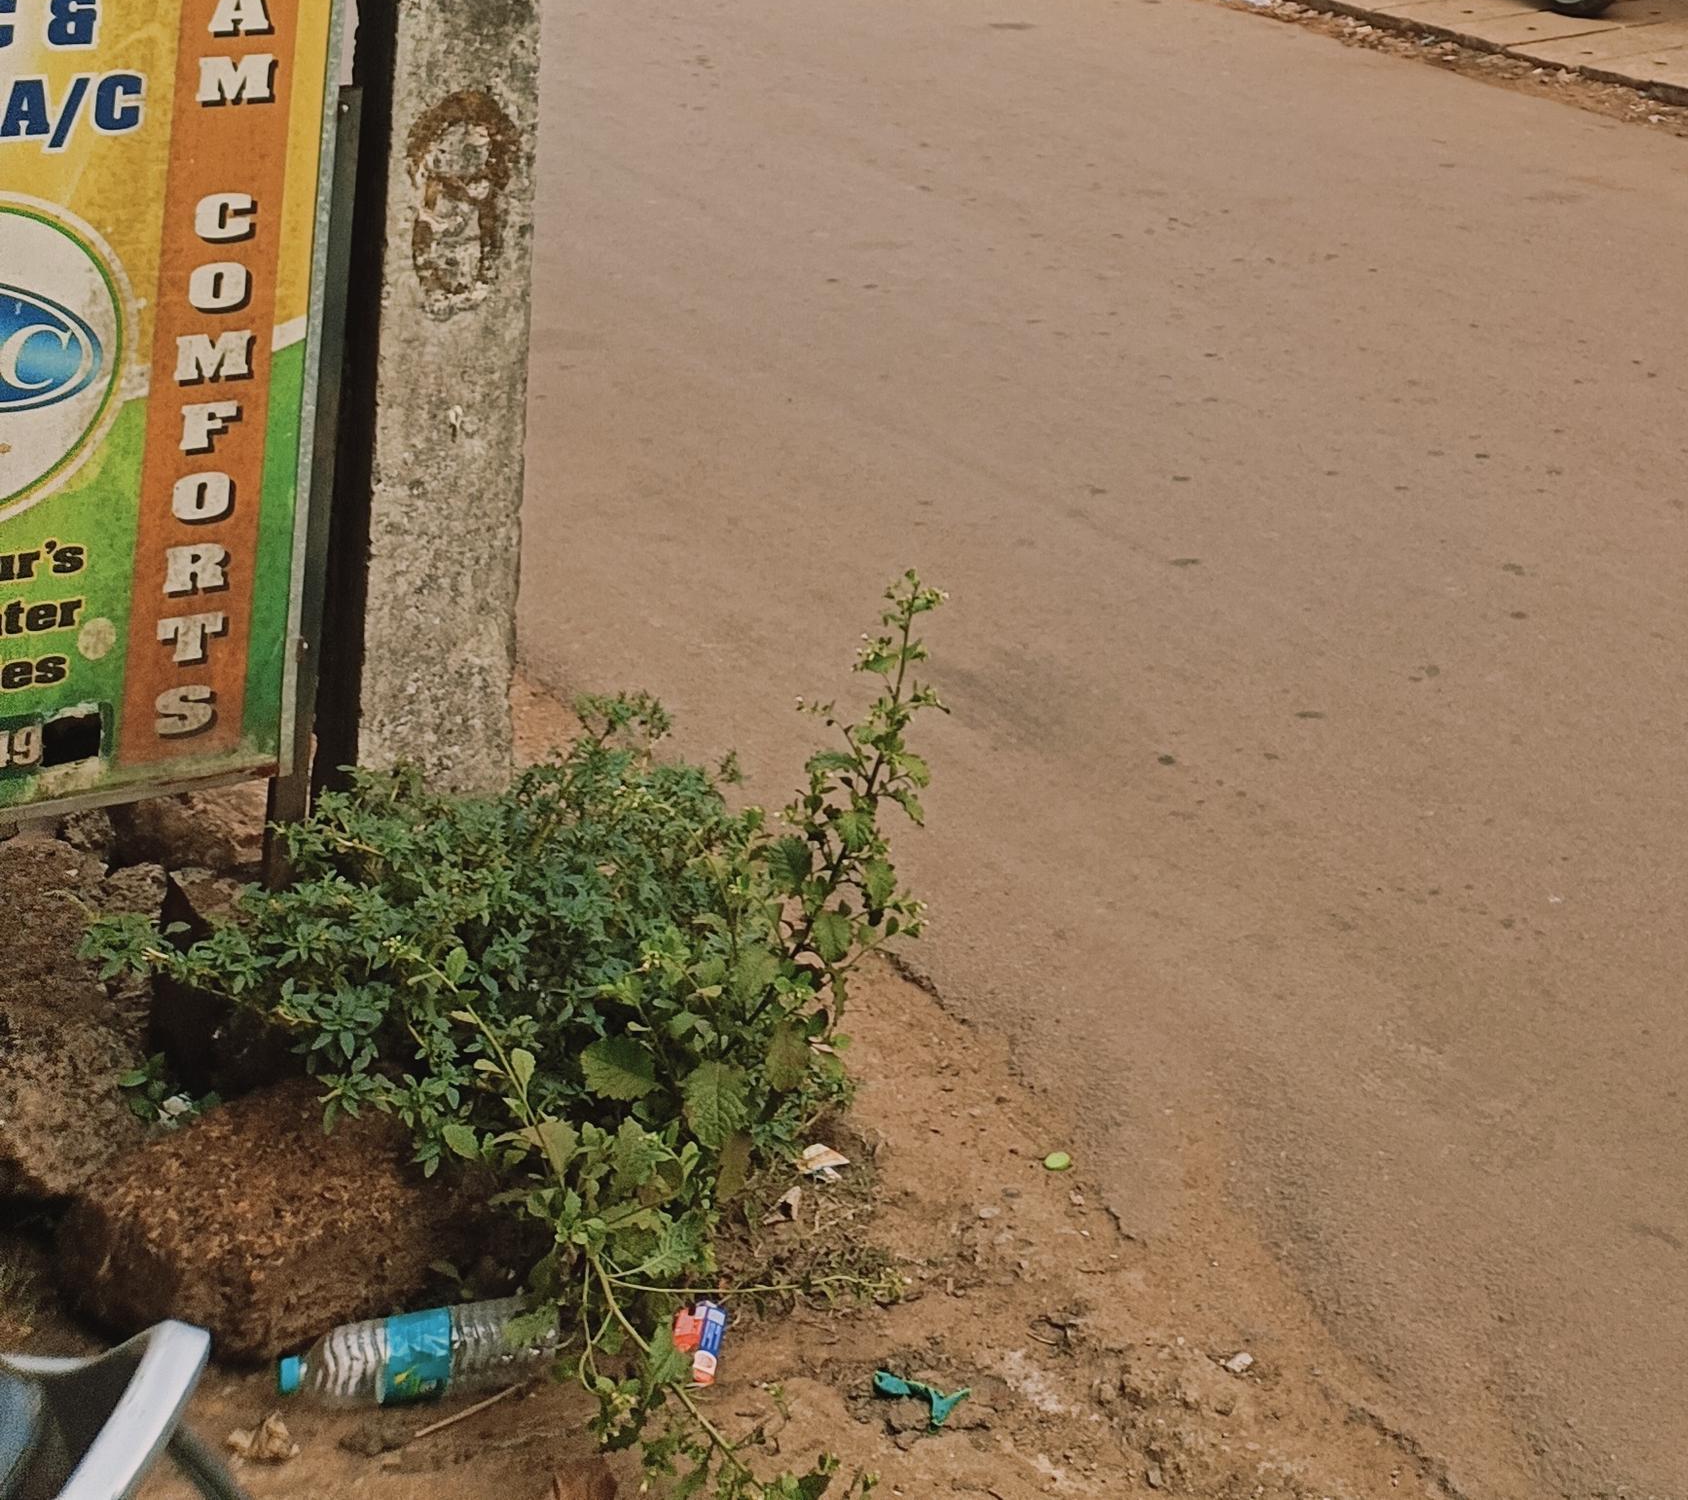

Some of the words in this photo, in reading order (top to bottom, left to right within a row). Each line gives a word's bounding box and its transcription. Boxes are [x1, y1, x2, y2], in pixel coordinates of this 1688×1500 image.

[0, 73, 144, 149] A/C
[154, 191, 258, 740] COMFORTS
[0, 599, 83, 636] ter
